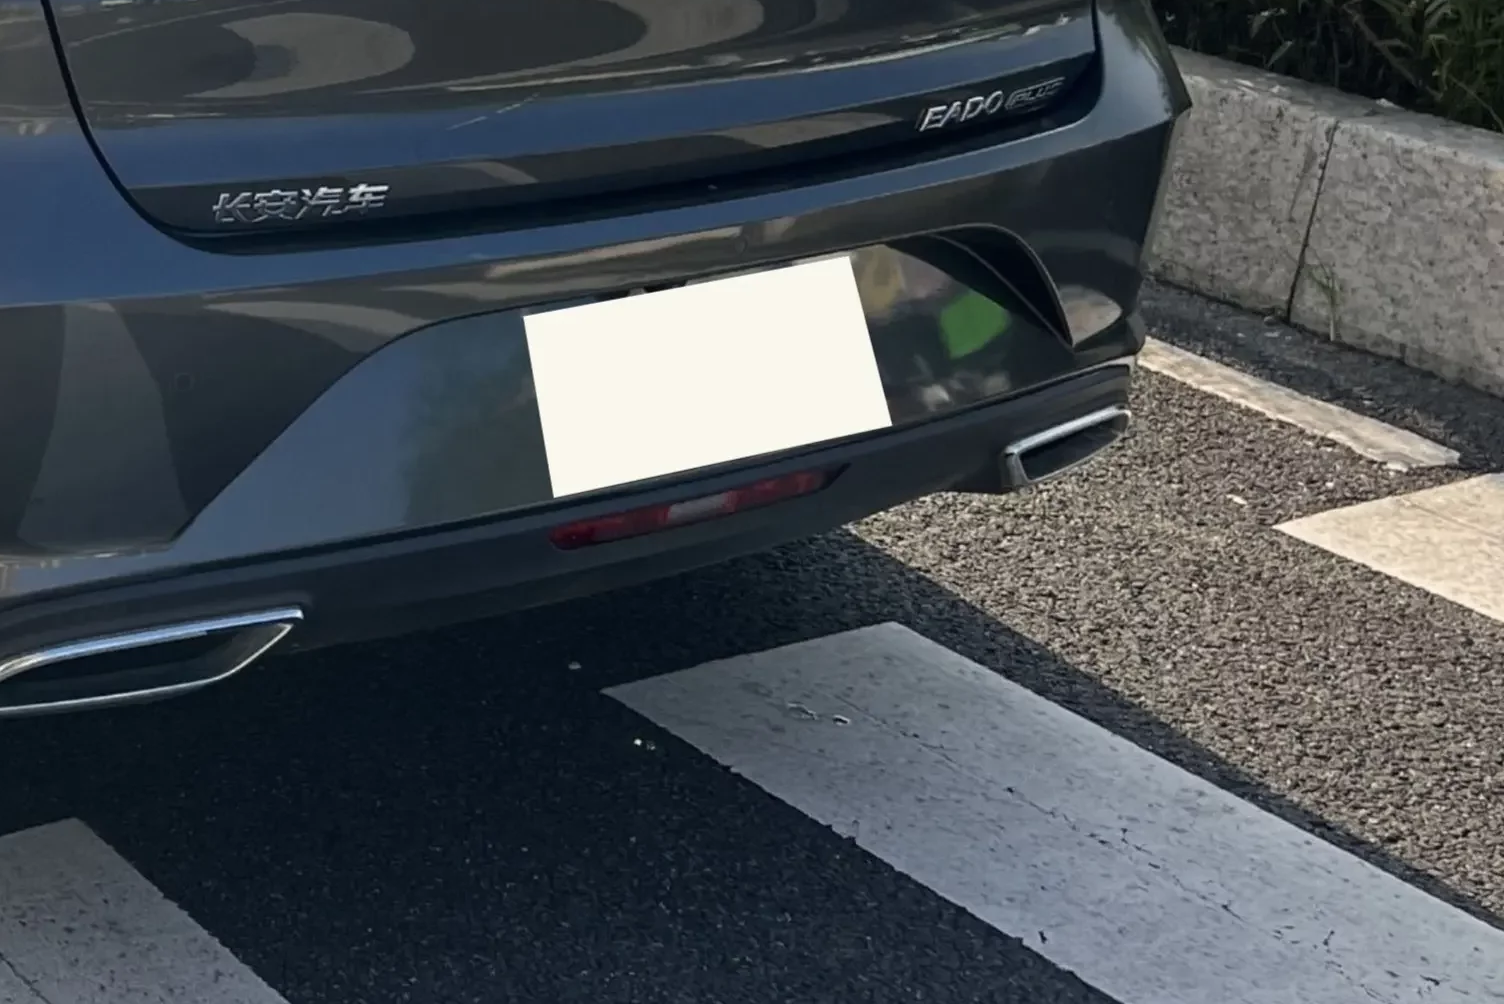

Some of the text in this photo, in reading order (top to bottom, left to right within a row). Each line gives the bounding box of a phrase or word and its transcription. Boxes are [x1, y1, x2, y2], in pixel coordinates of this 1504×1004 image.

[919, 90, 1003, 132] EADO
[212, 183, 390, 223] 长安汽车
